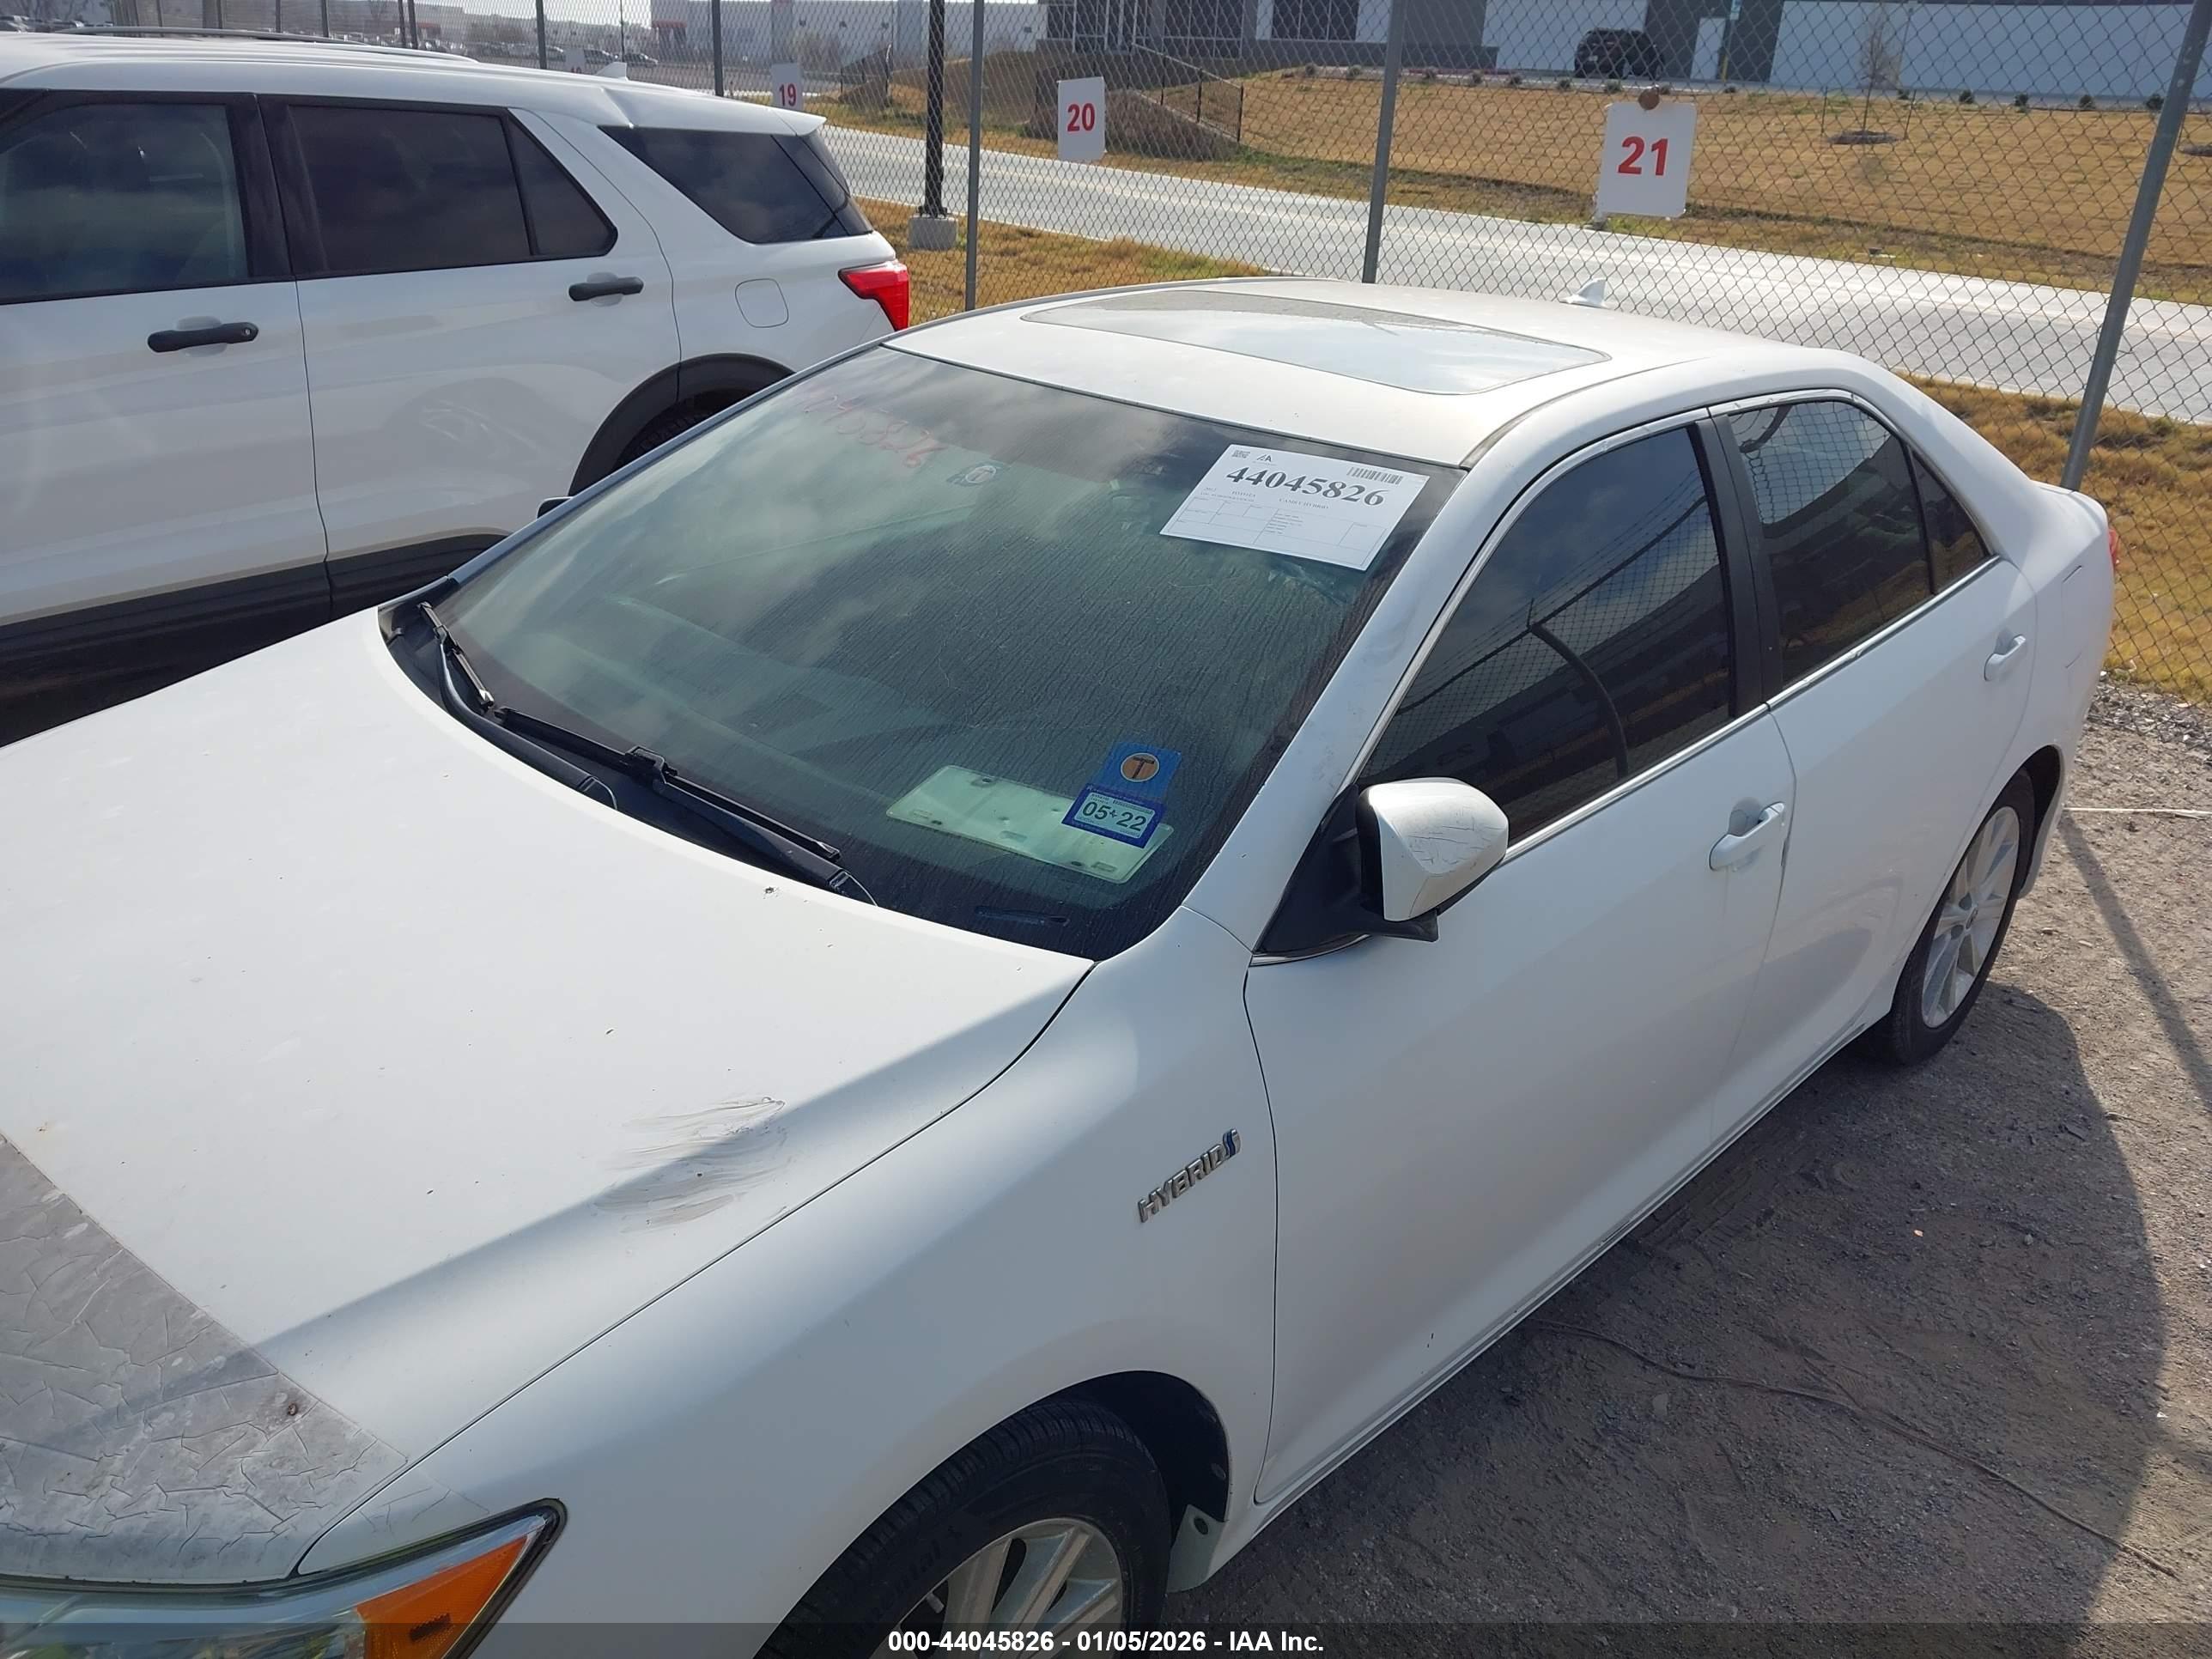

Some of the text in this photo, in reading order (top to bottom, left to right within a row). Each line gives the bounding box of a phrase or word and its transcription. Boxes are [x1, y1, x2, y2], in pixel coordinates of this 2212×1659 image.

[779, 82, 797, 106] 19
[1066, 102, 1096, 132] 20
[1617, 136, 1669, 176] 21
[1225, 466, 1389, 507] 44045826
[1082, 801, 1112, 820] 05
[1115, 811, 1147, 832] 22
[1138, 1143, 1228, 1223] HYBRID
